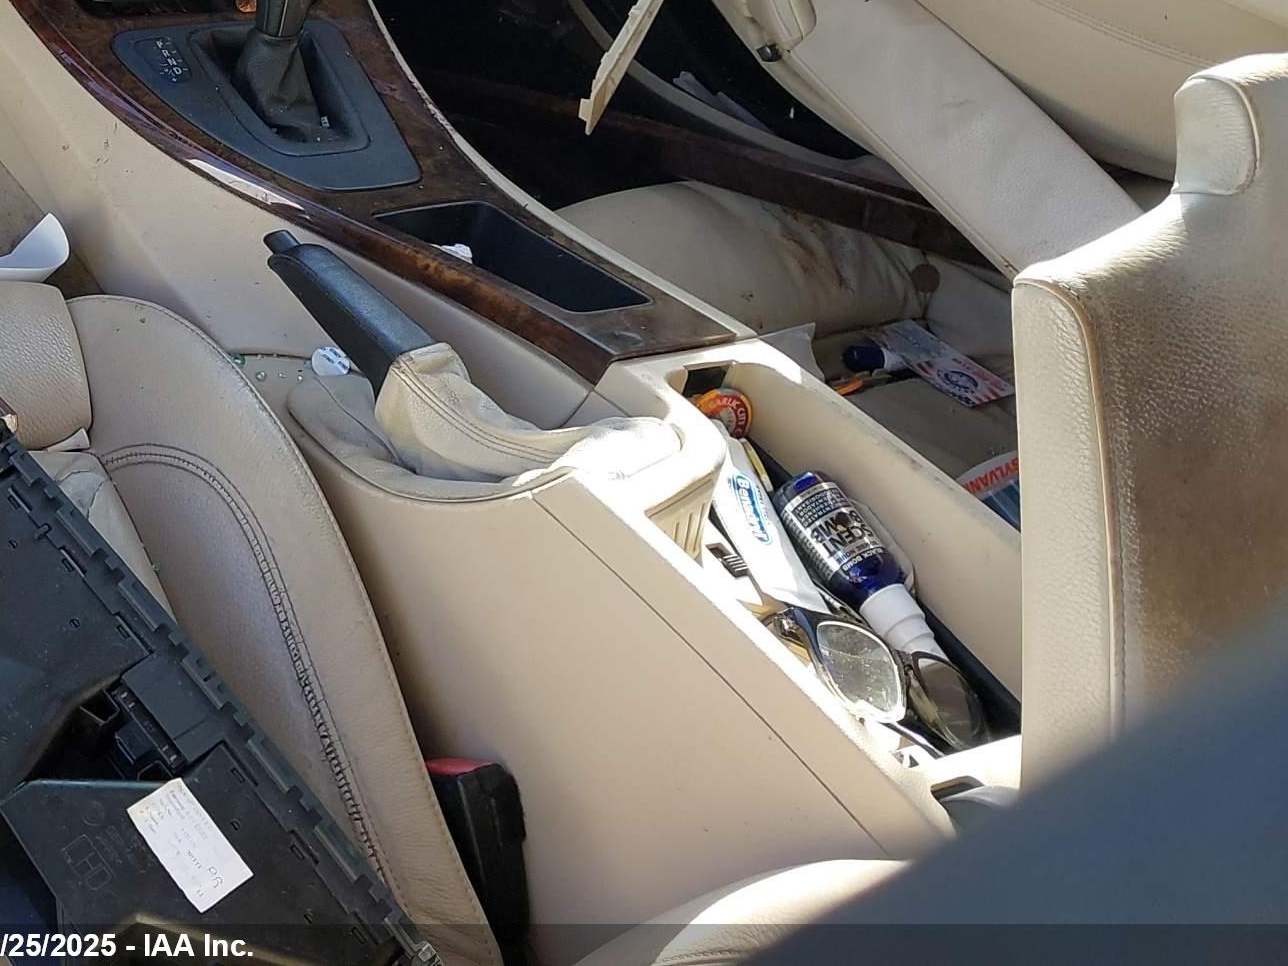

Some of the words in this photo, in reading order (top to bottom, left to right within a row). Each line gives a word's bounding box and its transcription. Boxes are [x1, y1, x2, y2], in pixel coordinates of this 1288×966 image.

[820, 521, 874, 559] SCENT
[862, 548, 885, 560] BLACK
[842, 555, 863, 571] BOMB
